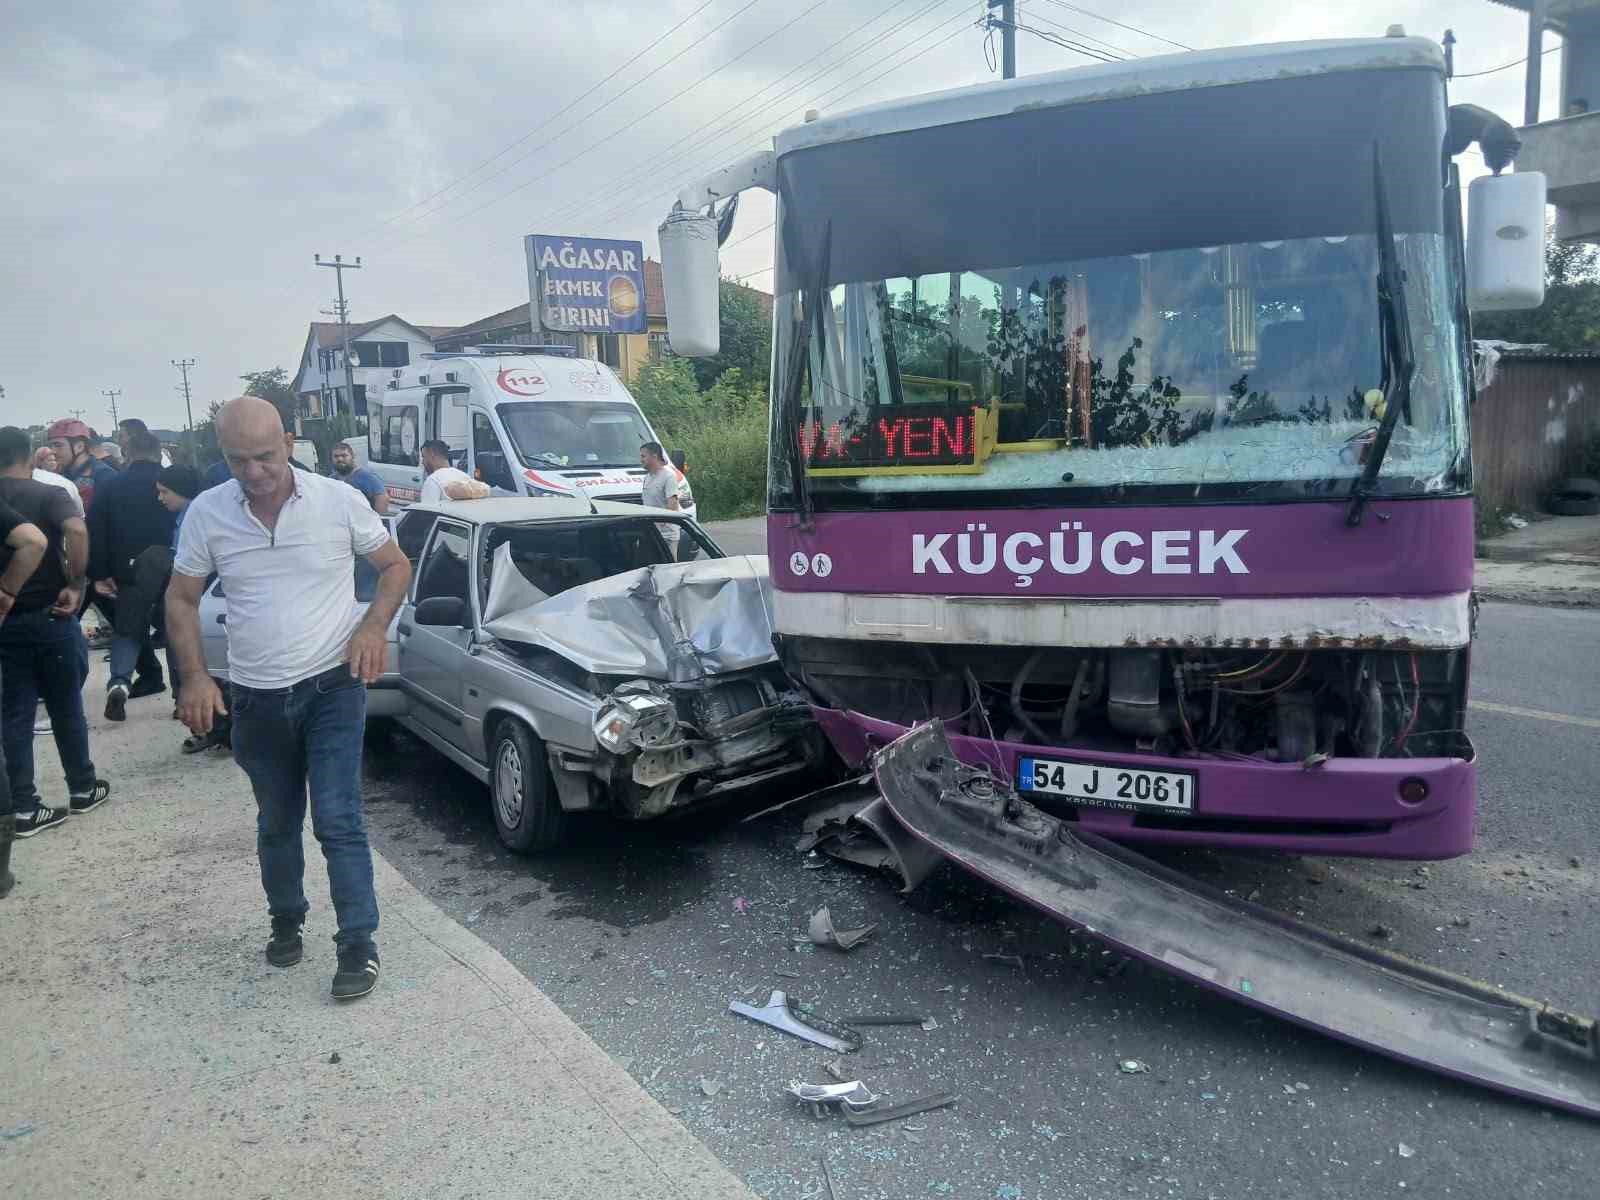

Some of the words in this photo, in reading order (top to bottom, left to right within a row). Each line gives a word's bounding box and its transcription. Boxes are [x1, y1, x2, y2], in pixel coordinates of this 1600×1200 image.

[541, 240, 637, 271] AĞASAR
[544, 280, 604, 296] EKMEK
[507, 376, 545, 386] 112
[912, 521, 1251, 587] KÜÇÜCEK
[1034, 763, 1065, 790] 54
[1083, 770, 1099, 794] J
[1117, 773, 1186, 804] 2061
